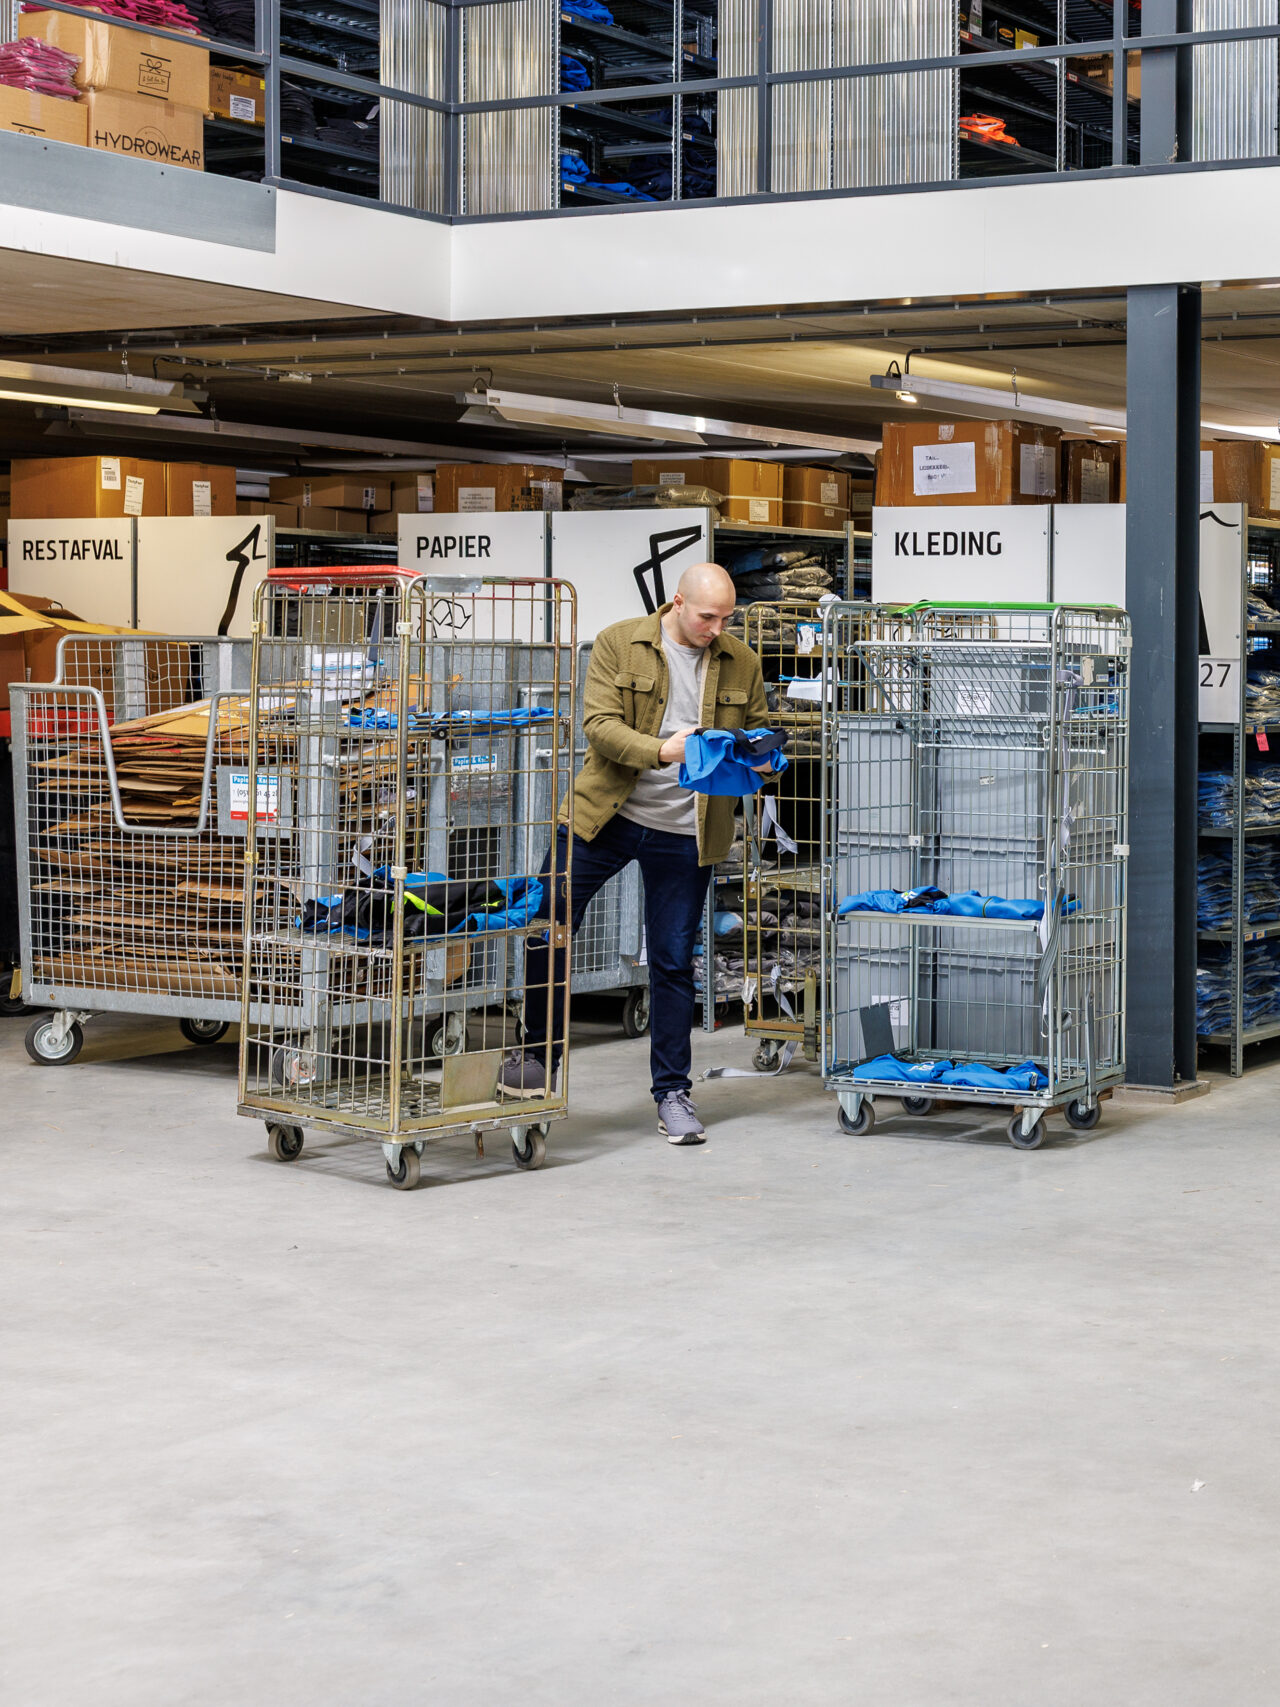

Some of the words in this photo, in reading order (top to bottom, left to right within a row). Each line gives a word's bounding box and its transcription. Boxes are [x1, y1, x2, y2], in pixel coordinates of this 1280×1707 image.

[95, 130, 200, 166] HYDROWEAR
[22, 539, 124, 561] RESTAFVAL
[416, 535, 491, 559] PAPIER
[894, 531, 1002, 556] KLEDING
[1200, 664, 1230, 687] 27
